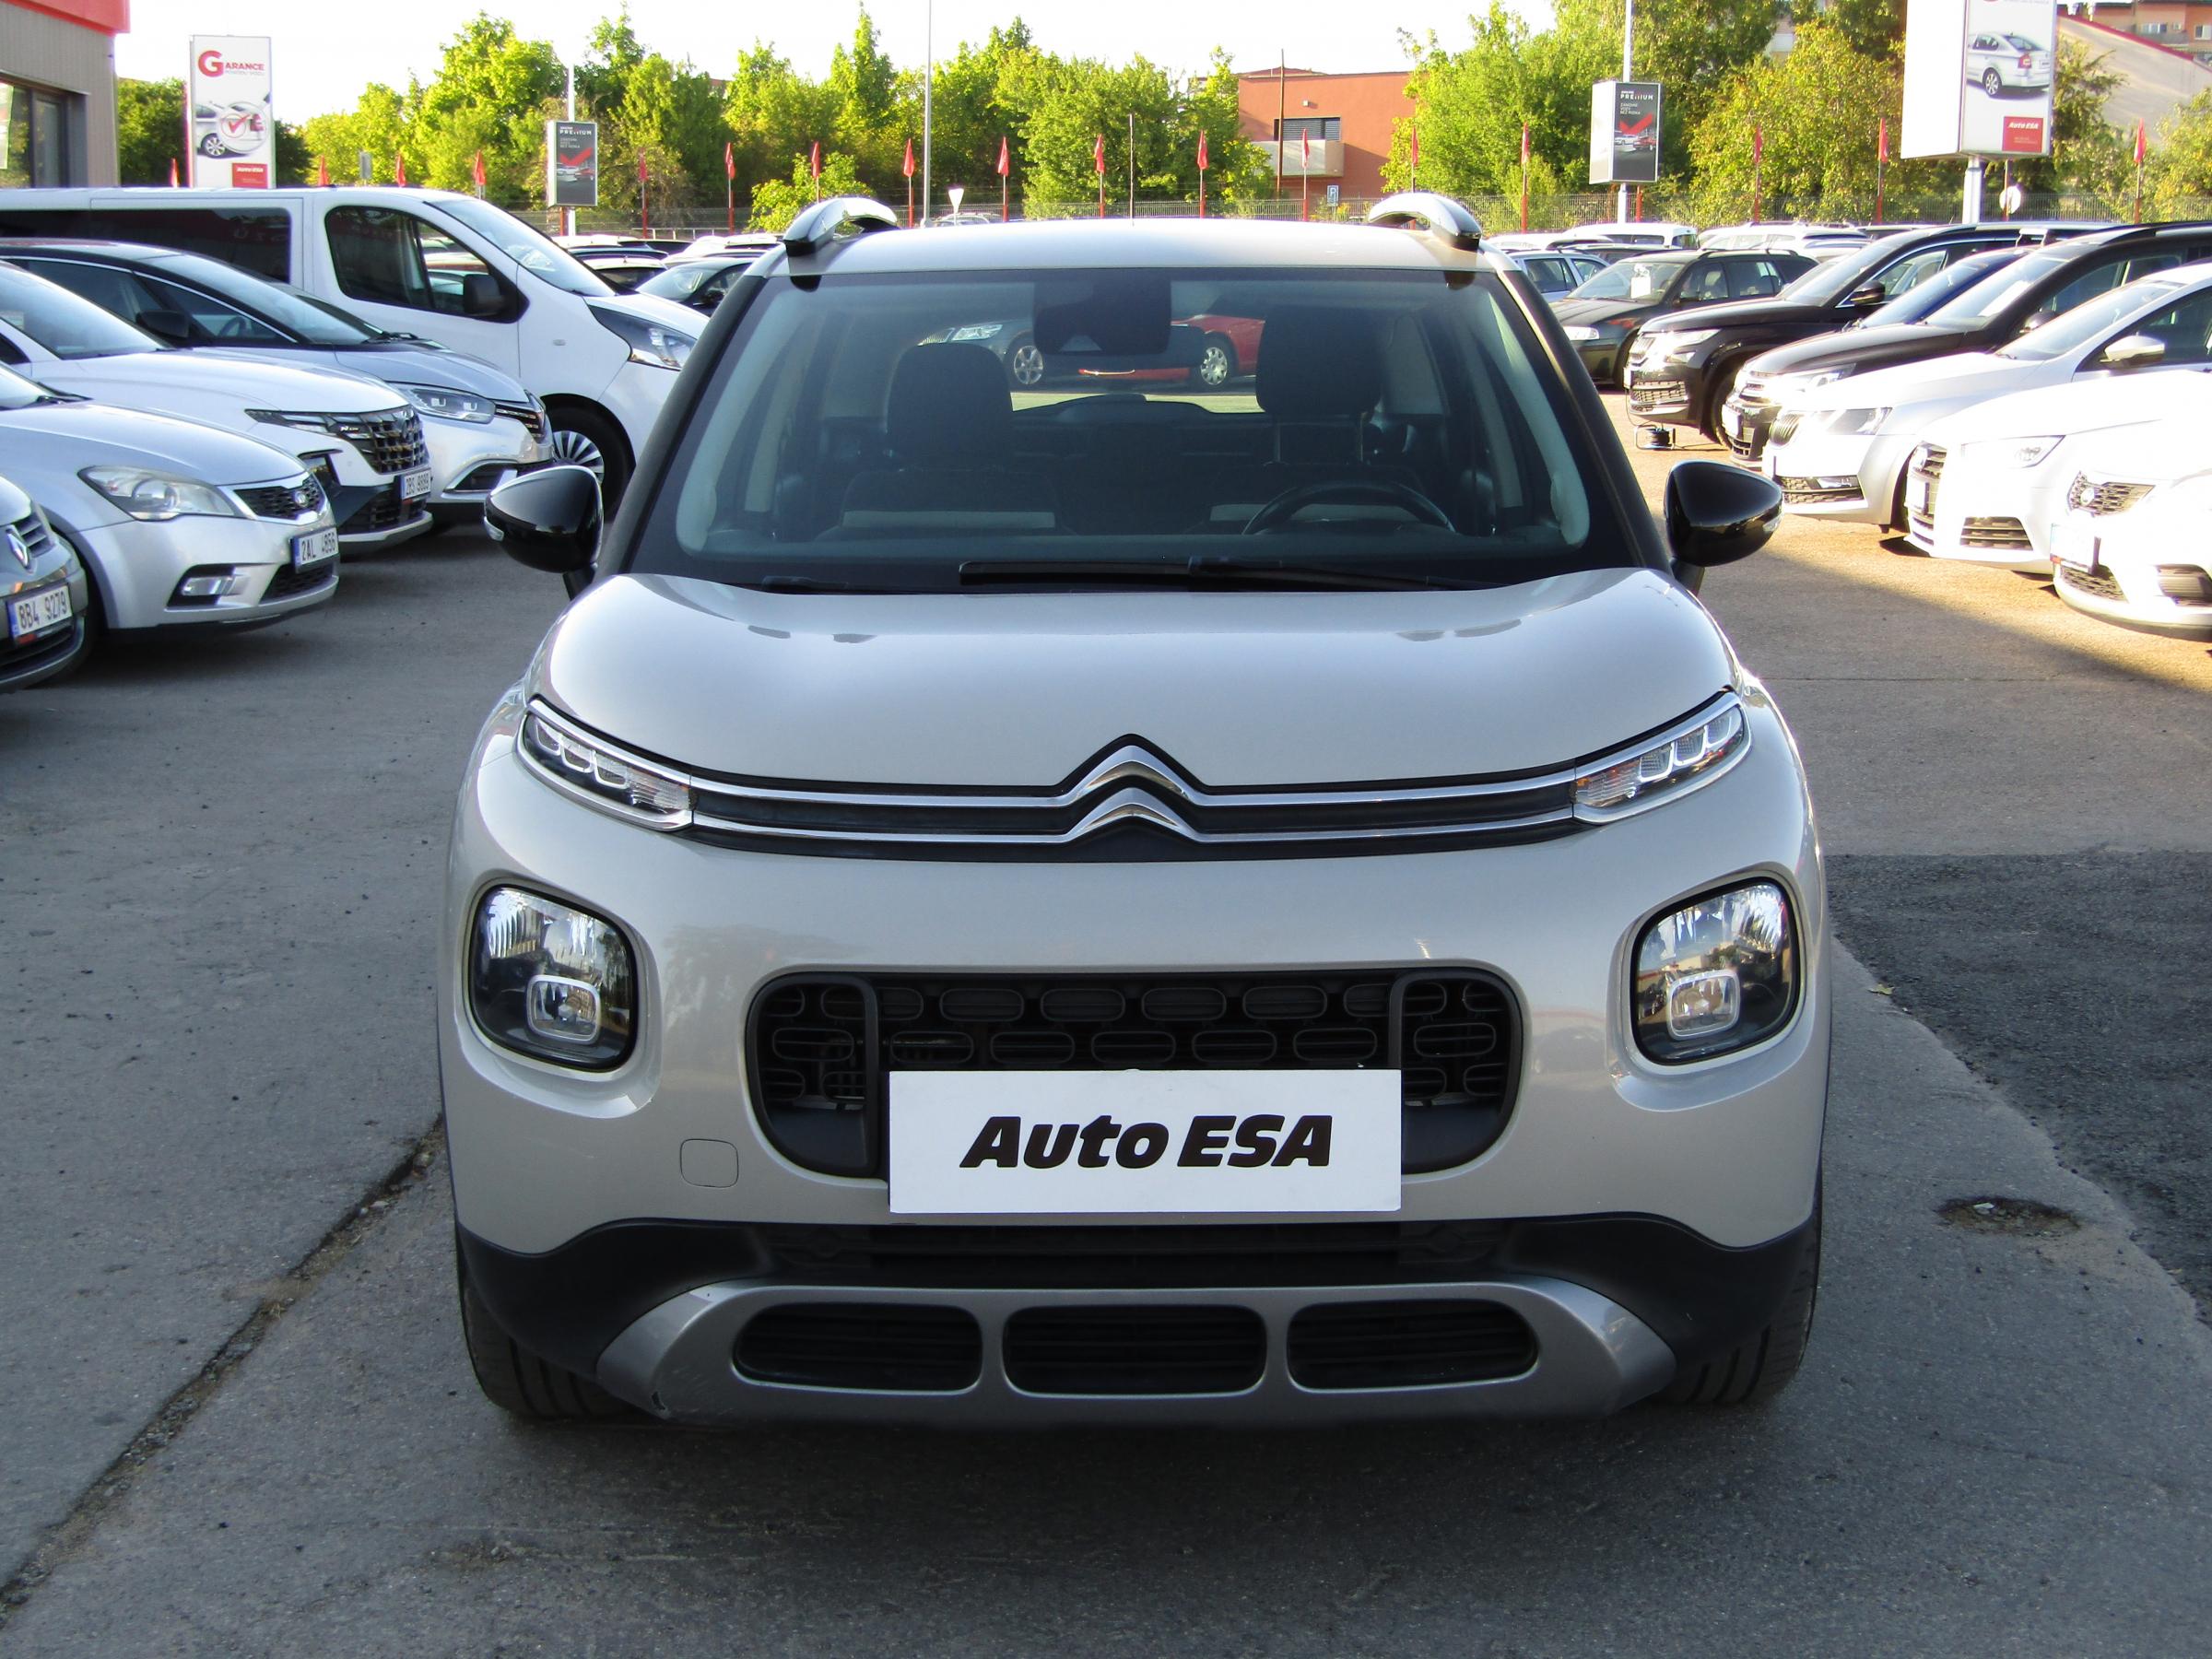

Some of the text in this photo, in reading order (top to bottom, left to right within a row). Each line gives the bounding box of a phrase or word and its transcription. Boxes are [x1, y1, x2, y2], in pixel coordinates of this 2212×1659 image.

[301, 537, 316, 560] 2AL
[18, 590, 67, 629] 8B4 9279
[959, 1113, 1333, 1170] Auto ESA
